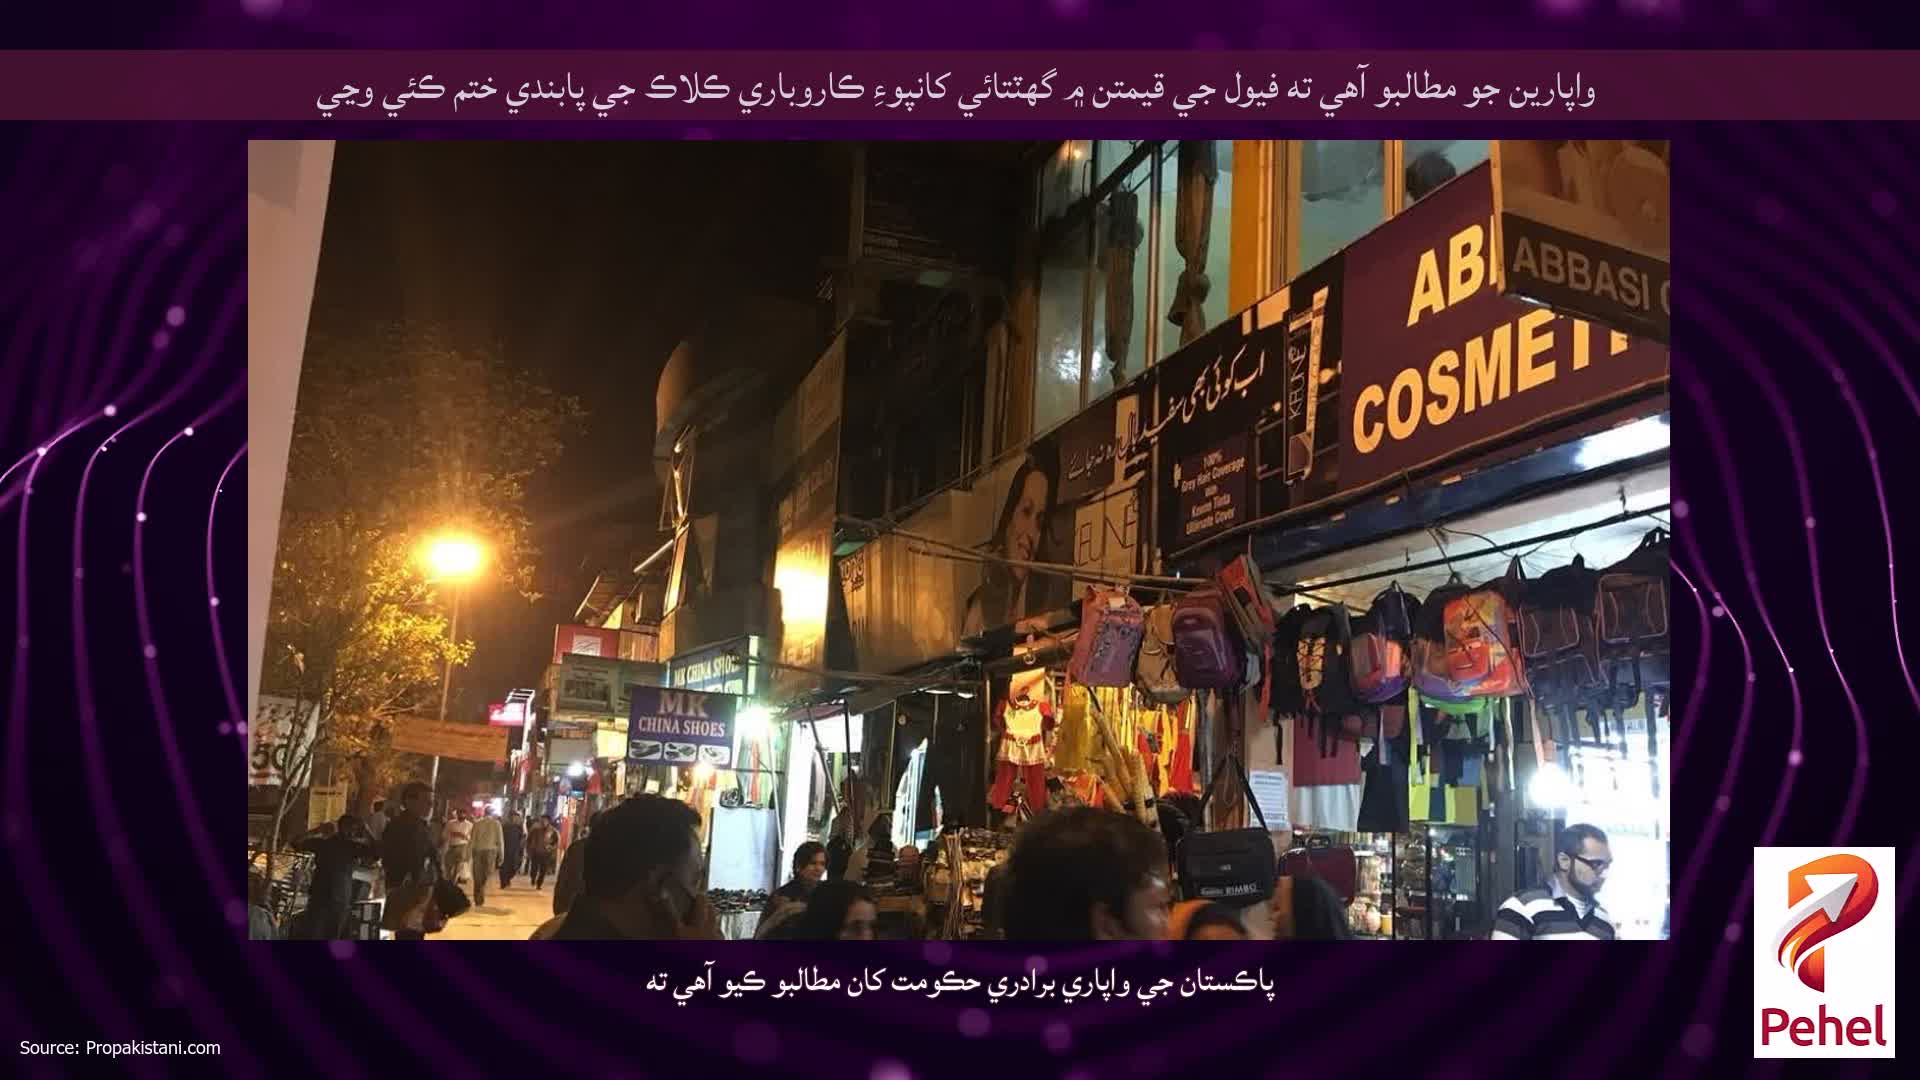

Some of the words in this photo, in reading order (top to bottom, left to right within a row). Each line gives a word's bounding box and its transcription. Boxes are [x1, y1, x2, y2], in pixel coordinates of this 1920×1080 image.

[1512, 236, 1649, 312] ABBASI
[686, 660, 711, 684] CHINA
[658, 689, 709, 719] MK
[638, 715, 680, 735] CHINA
[683, 718, 726, 738] SHOES
